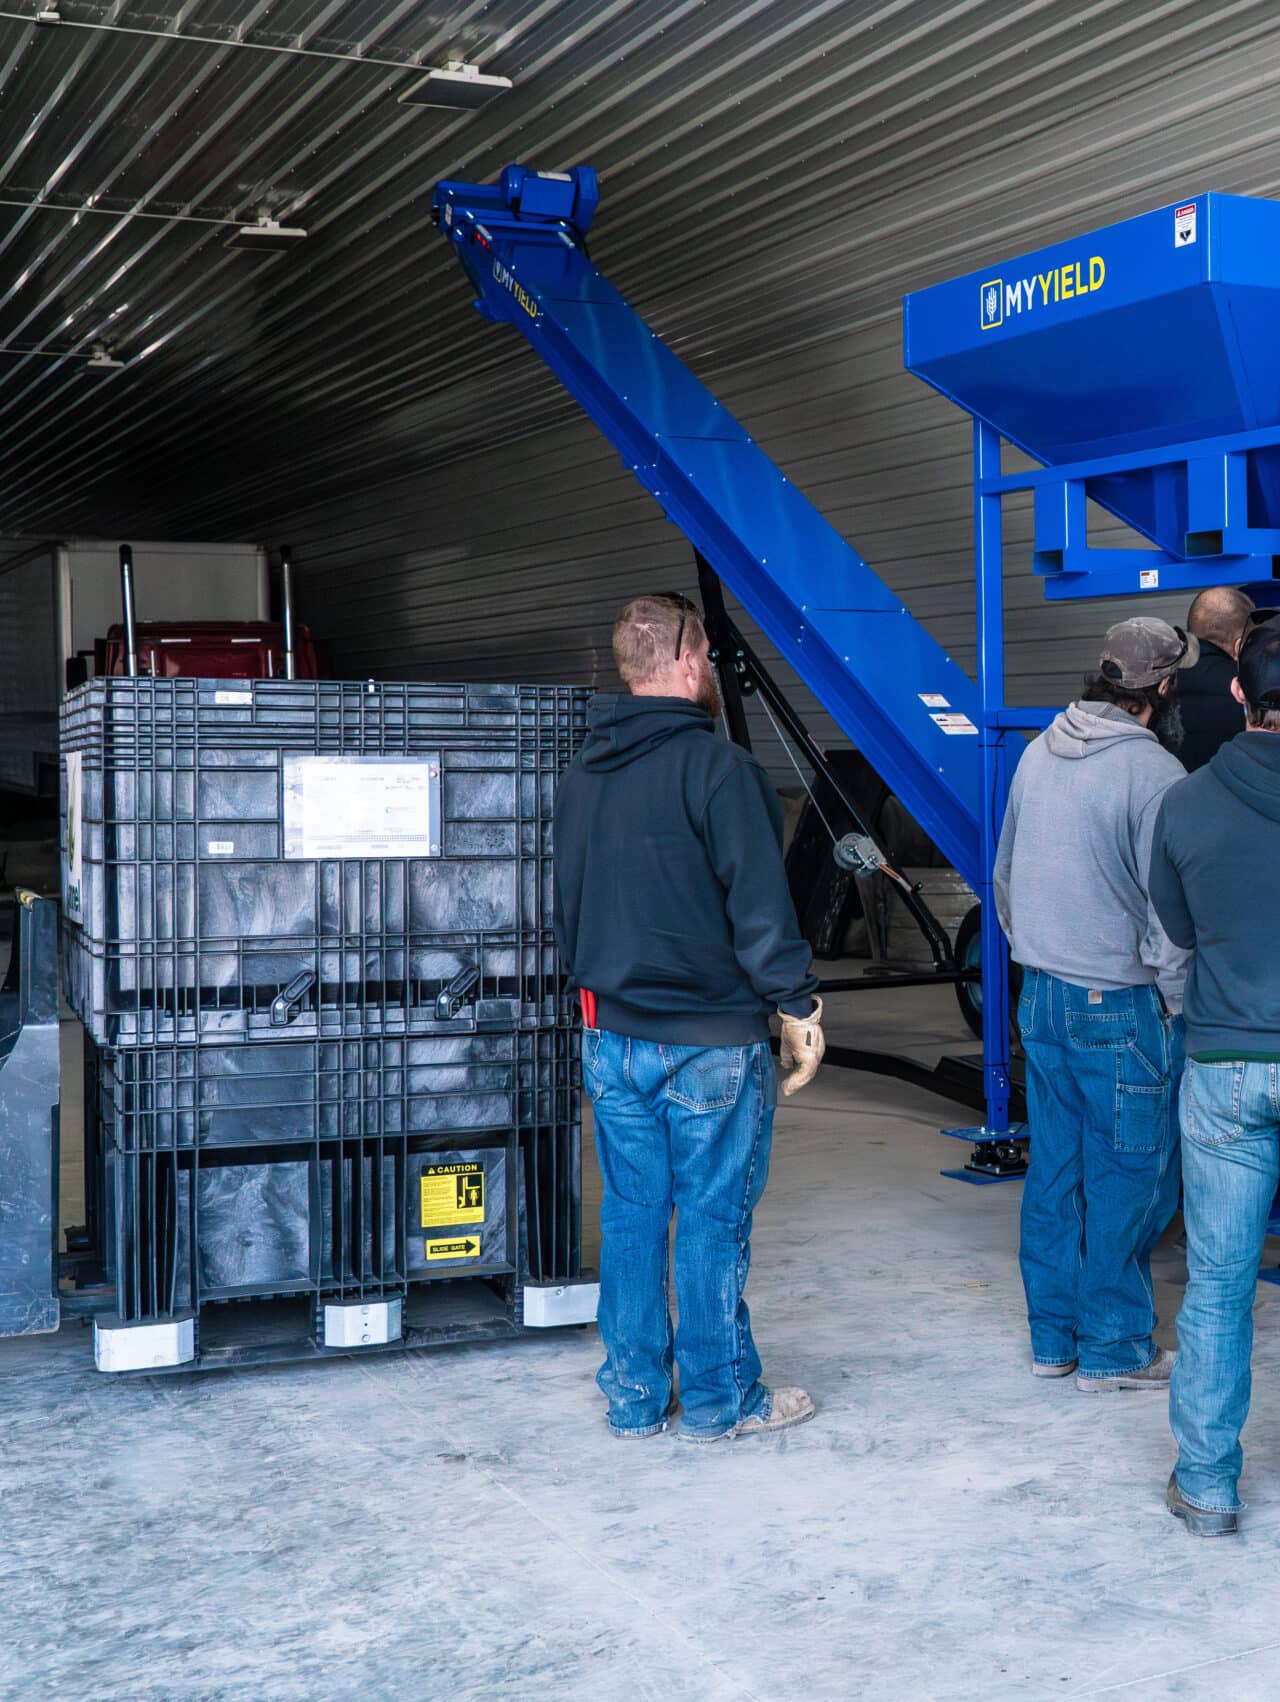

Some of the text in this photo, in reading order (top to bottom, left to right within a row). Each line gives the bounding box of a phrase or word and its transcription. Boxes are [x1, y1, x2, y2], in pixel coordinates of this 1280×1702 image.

[501, 267, 537, 318] MYYIELD
[1005, 255, 1106, 317] MYYIELD
[437, 1164, 477, 1174] CAUTION
